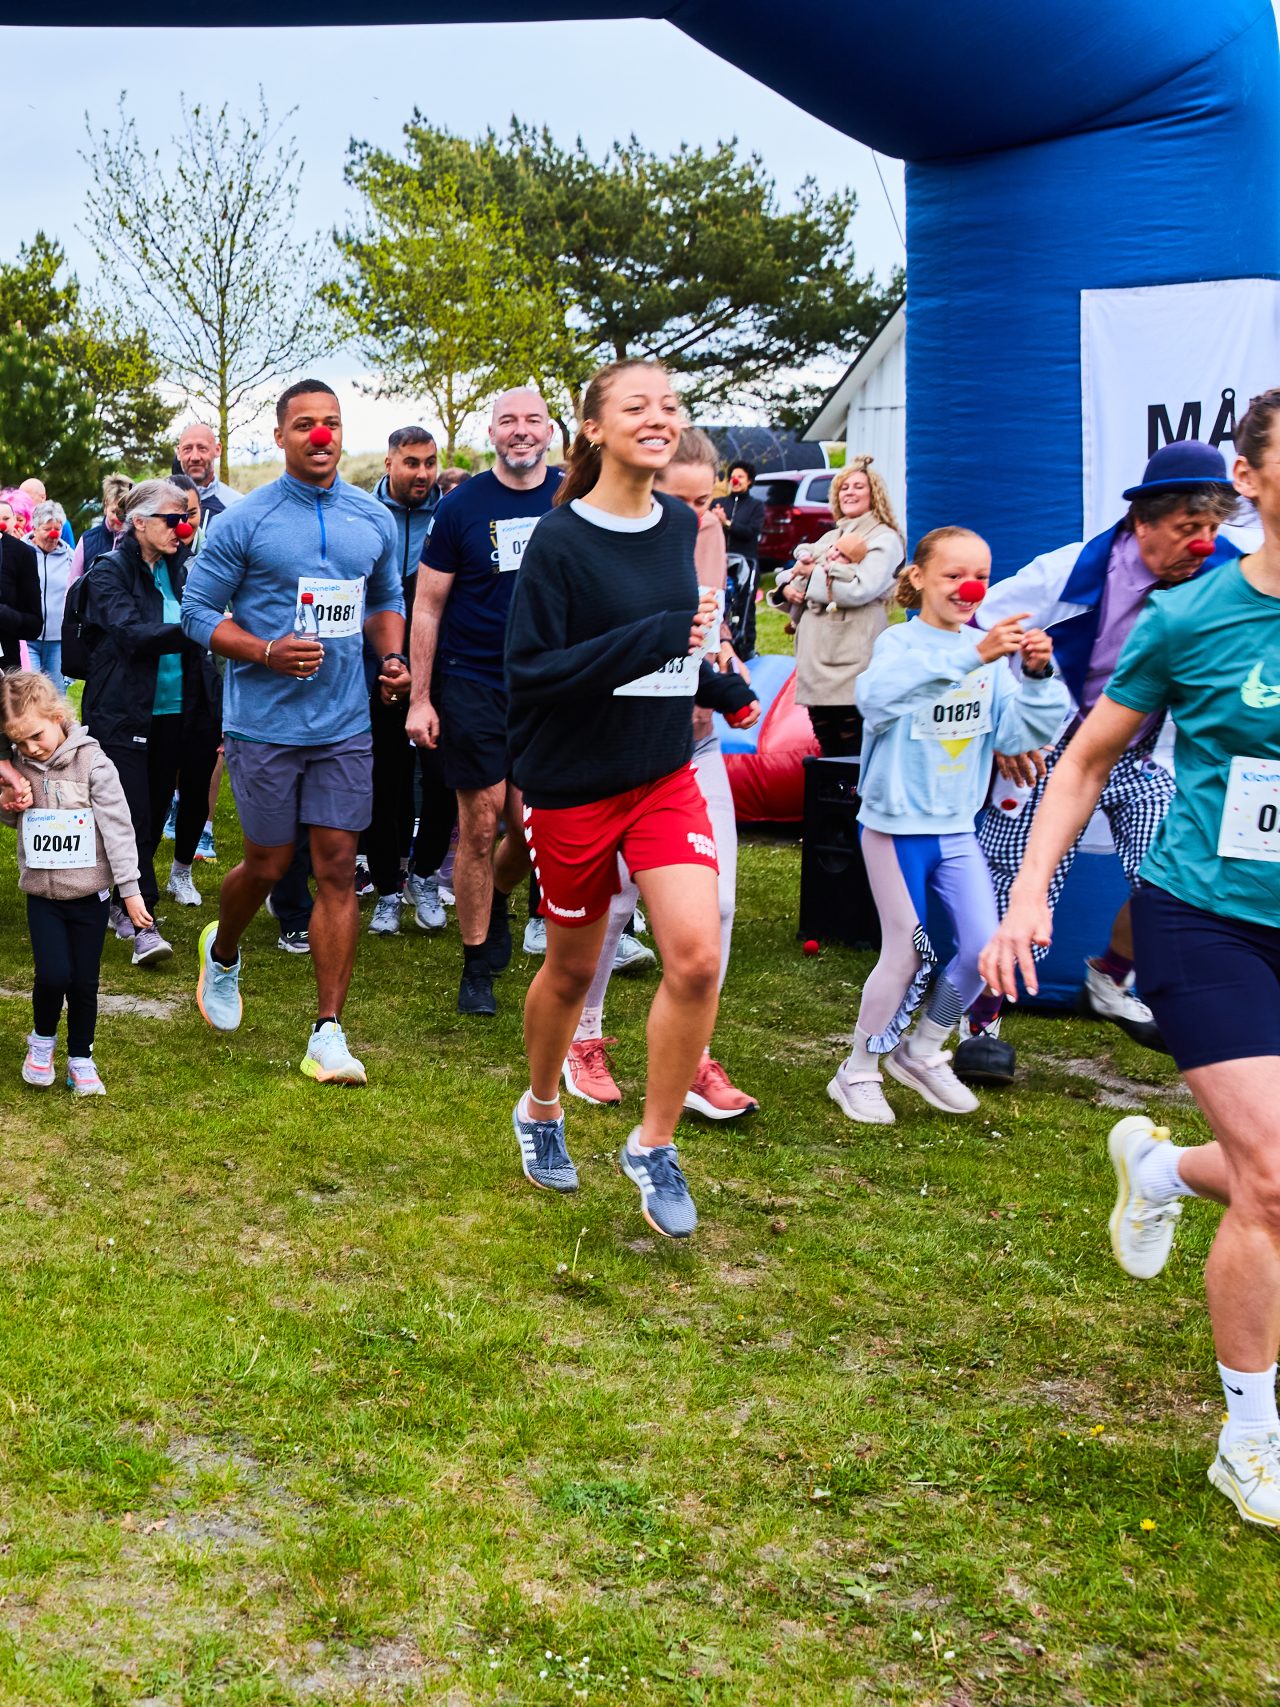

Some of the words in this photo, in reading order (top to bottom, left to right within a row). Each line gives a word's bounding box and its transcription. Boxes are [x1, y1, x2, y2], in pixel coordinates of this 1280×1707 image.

[1147, 387, 1241, 460] MÅ
[316, 604, 356, 622] 01881
[933, 700, 981, 723] 01879
[33, 834, 81, 852] 02047
